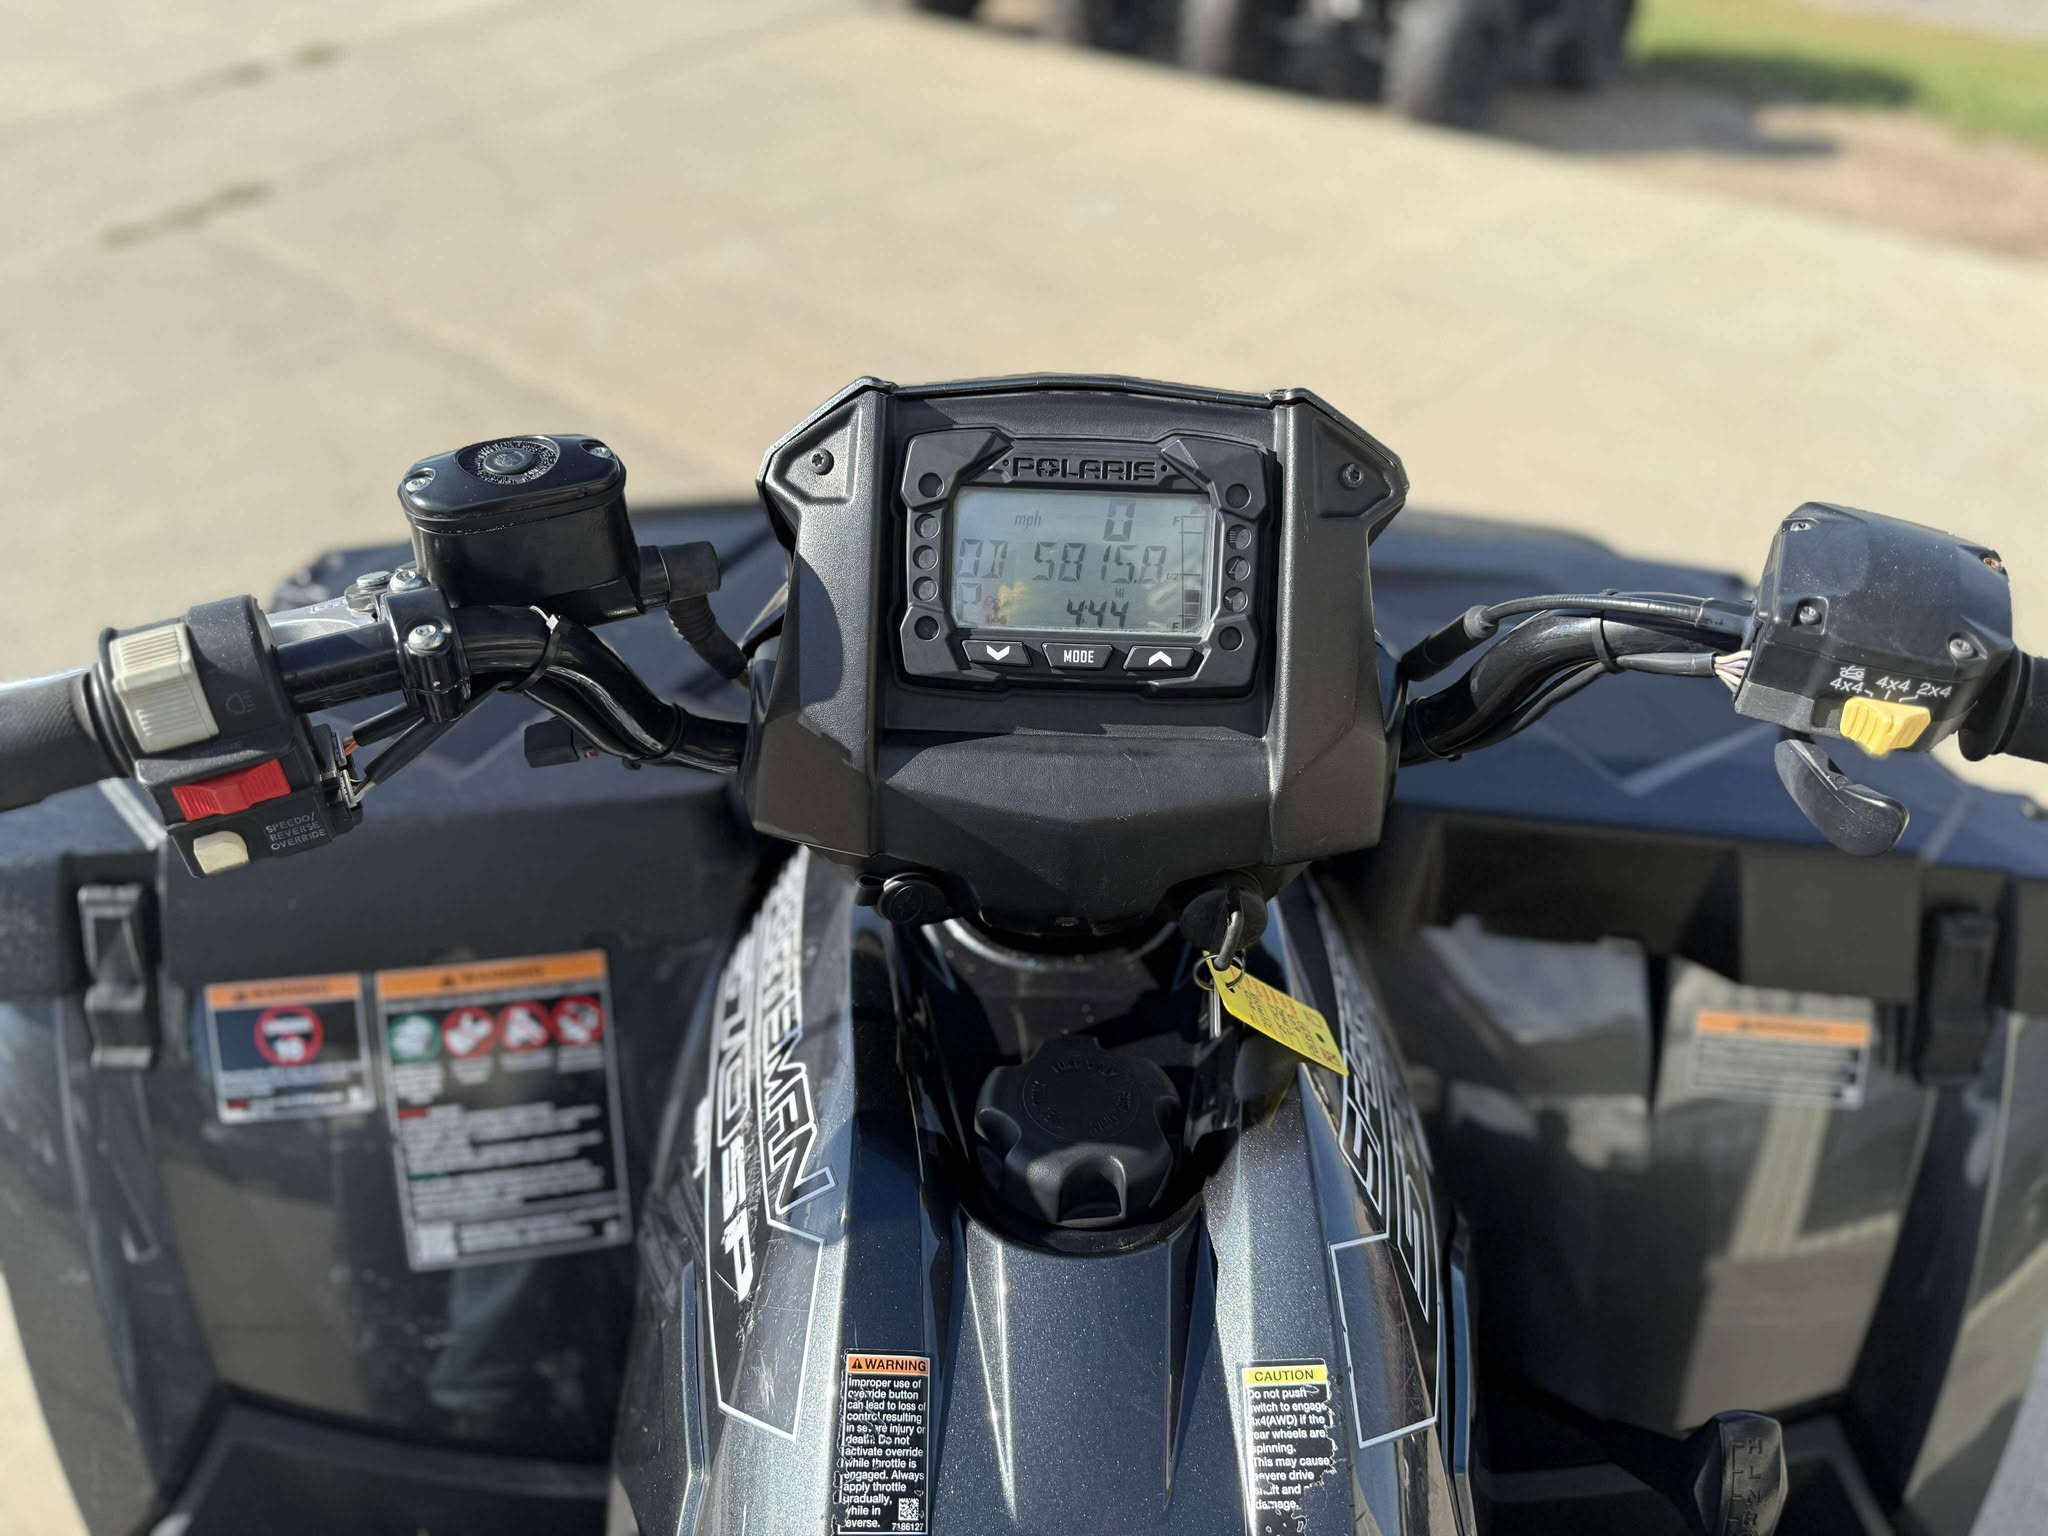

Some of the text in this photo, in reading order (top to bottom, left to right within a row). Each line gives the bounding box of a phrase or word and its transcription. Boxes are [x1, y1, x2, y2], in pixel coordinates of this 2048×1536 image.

[1012, 457, 1156, 481] POLARIS
[1014, 499, 1136, 542] mph 0
[1066, 599, 1129, 628] 4:44
[1063, 650, 1094, 664] MODE
[1829, 677, 1864, 694] 4x4
[1875, 676, 1911, 692] 4x4
[1916, 682, 1952, 698] 2x4
[265, 812, 316, 834] SPEEDO/
[269, 820, 321, 842] REVERSE
[270, 829, 328, 851] OVERRIDE
[865, 1359, 926, 1372] WARNING
[1254, 1370, 1314, 1382] CAUTION
[848, 1377, 892, 1389] Improper
[912, 1379, 922, 1388] of
[889, 1390, 919, 1400] button
[1248, 1388, 1308, 1400] Do not push
[848, 1400, 926, 1411] can lead to loss of
[1280, 1402, 1290, 1412] to
[1292, 1402, 1327, 1413] engage
[847, 1412, 922, 1424] control resulting
[1300, 1414, 1307, 1424] if
[1308, 1414, 1326, 1424] the
[846, 1422, 926, 1436] in sere injury or
[1272, 1428, 1308, 1440] wheels
[1310, 1429, 1326, 1438] are
[878, 1434, 892, 1445] Do
[894, 1435, 910, 1445] not
[845, 1446, 924, 1456] activate override
[845, 1458, 917, 1468] while throttle is
[1252, 1456, 1330, 1468] This may cause
[844, 1470, 924, 1482] engaged. Always
[1254, 1470, 1314, 1481] severe drive
[843, 1481, 907, 1494] apply throttle
[1282, 1484, 1302, 1494] and
[871, 1506, 881, 1516] in
[846, 1520, 924, 1532] everse. 7186127
